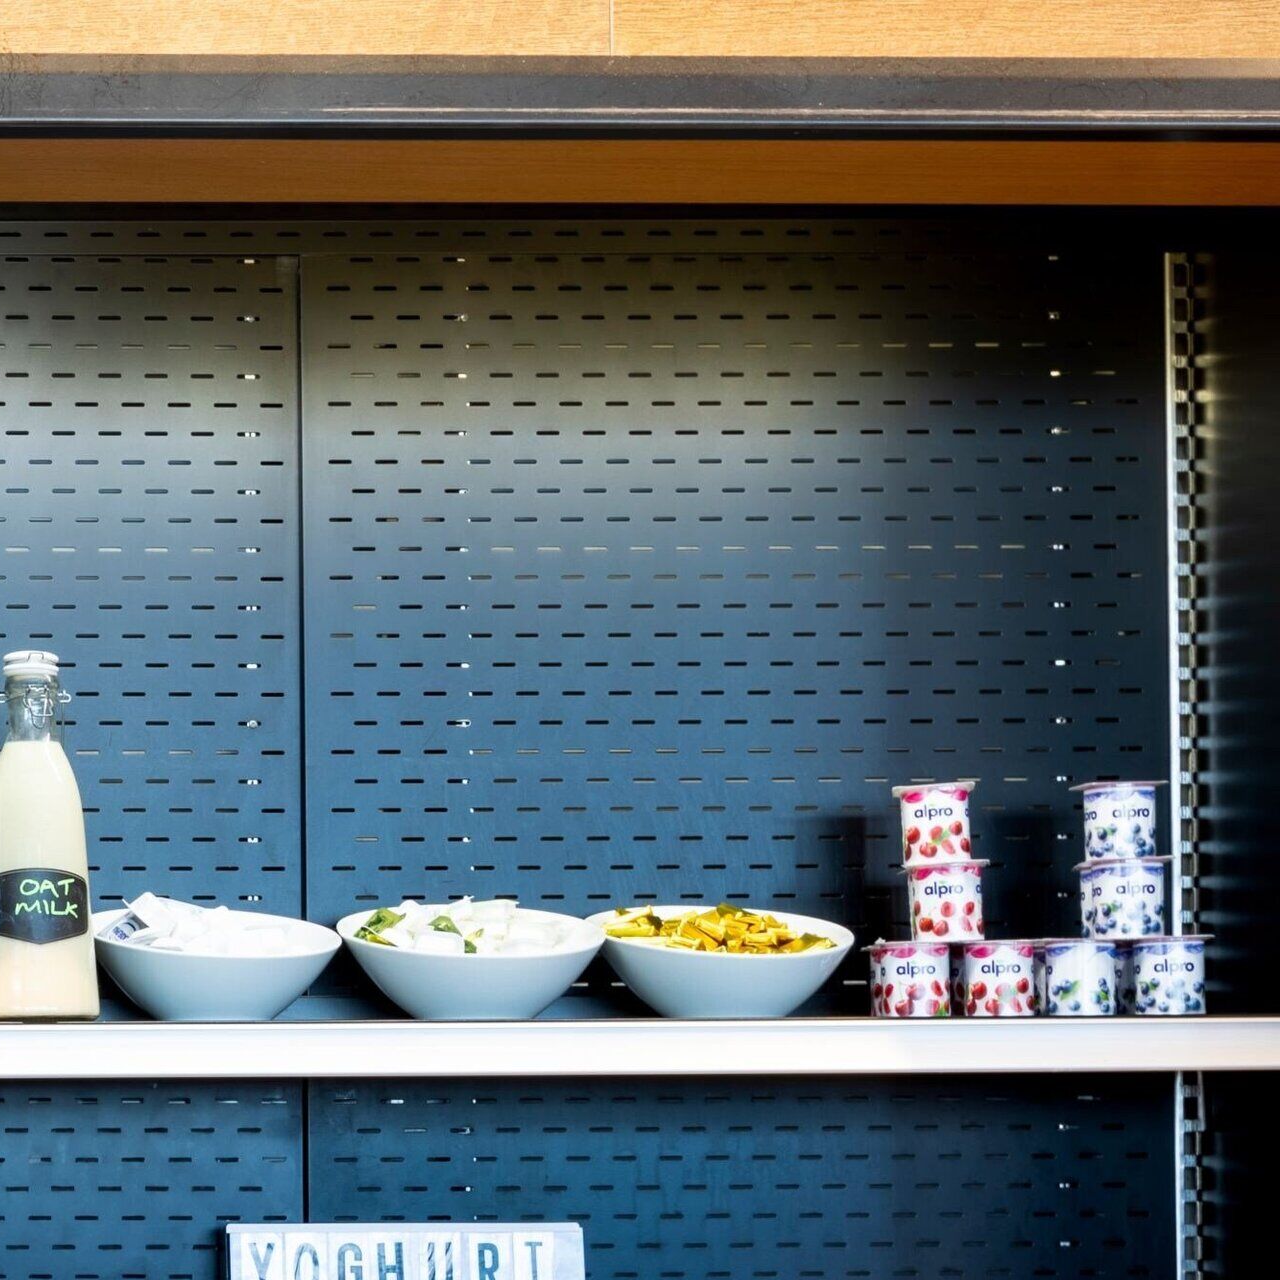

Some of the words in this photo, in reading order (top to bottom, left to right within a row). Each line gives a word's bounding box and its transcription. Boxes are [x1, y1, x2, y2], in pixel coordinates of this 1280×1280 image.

[914, 805, 953, 820] alpro
[1112, 804, 1150, 820] alpro
[19, 878, 75, 898] OAT
[924, 881, 963, 898] alpro
[1116, 881, 1155, 897] alpro
[15, 899, 78, 919] MILK
[896, 961, 936, 978] alpro
[981, 960, 1021, 977] alpro
[1154, 959, 1195, 976] alpro
